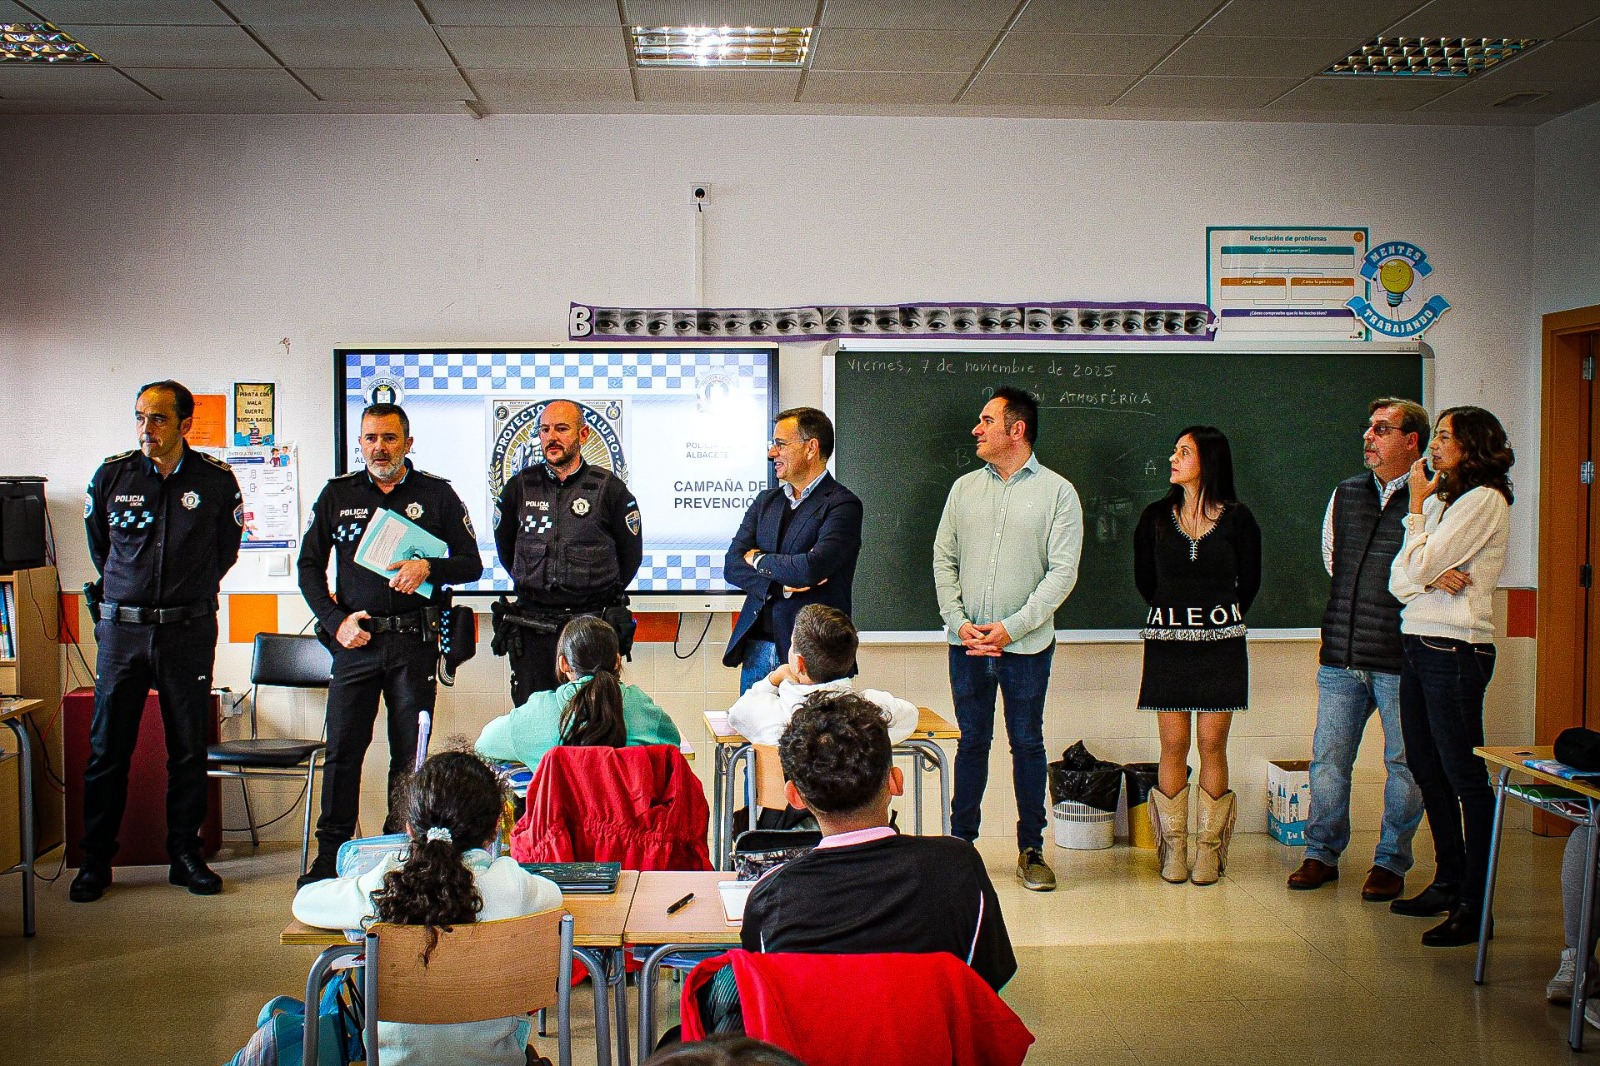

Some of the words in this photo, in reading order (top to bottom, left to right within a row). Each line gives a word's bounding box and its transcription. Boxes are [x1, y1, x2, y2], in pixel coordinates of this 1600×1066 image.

[1249, 234, 1284, 242] Resolución
[1284, 234, 1293, 242] de
[1294, 234, 1328, 243] problemas
[1370, 245, 1421, 263] MENTES
[570, 306, 592, 337] B
[1364, 309, 1433, 333] TRABAJANDO
[922, 359, 930, 374] 7
[936, 357, 956, 374] de
[965, 358, 1035, 374] noviembre
[1047, 360, 1064, 376] de
[1072, 364, 1117, 377] 2025
[496, 404, 546, 454] PROYECTO
[581, 407, 620, 453] TALURO
[674, 478, 744, 492] CAMPAÑA
[748, 480, 767, 492] DE
[114, 494, 145, 503] POLICIA
[525, 500, 550, 508] POLICIA
[674, 494, 757, 509] PREVENCIÓ
[339, 507, 369, 518] POLICIA
